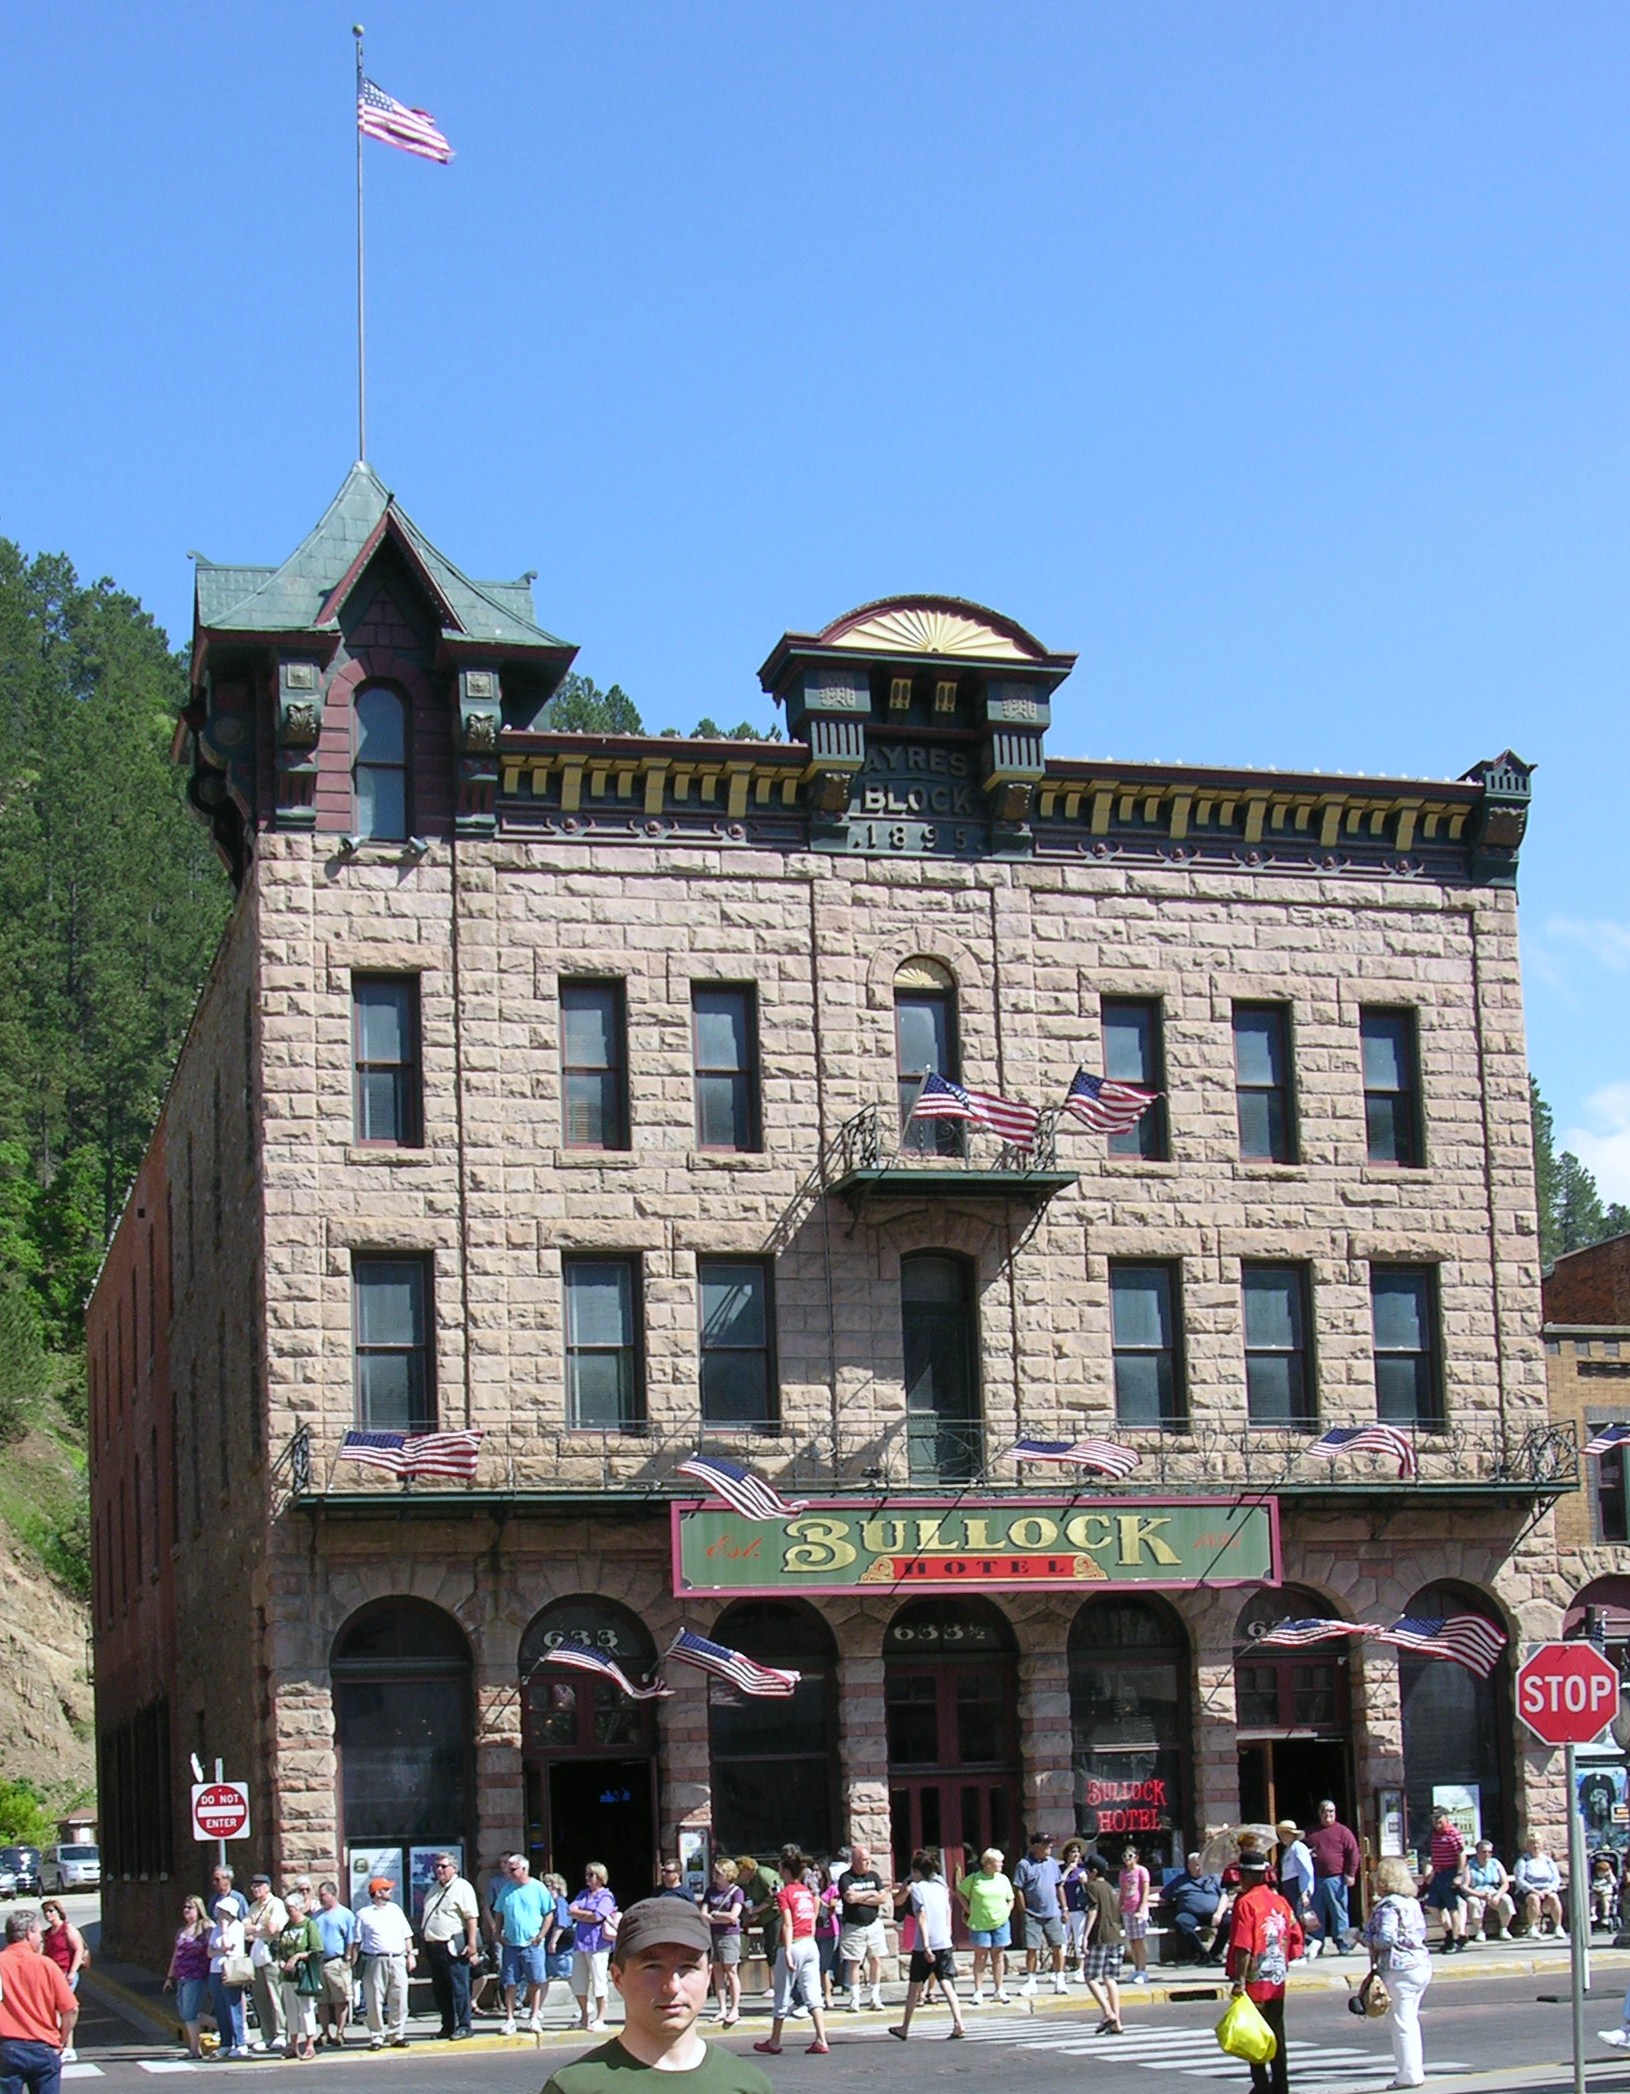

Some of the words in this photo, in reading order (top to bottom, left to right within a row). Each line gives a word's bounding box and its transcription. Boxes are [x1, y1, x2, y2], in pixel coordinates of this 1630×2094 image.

[863, 745, 968, 776] AYRES
[864, 782, 972, 814] BLOCK
[781, 1513, 1183, 1573] BULLOCK
[904, 1560, 1064, 1575] HOTEL
[543, 1629, 618, 1649] 633
[1523, 1675, 1612, 1713] STOP
[201, 1795, 215, 1805] DO
[220, 1794, 239, 1804] NOT
[1086, 1779, 1168, 1806] BULLOCK
[206, 1818, 237, 1829] ENTER
[1097, 1808, 1162, 1832] HOTEL
